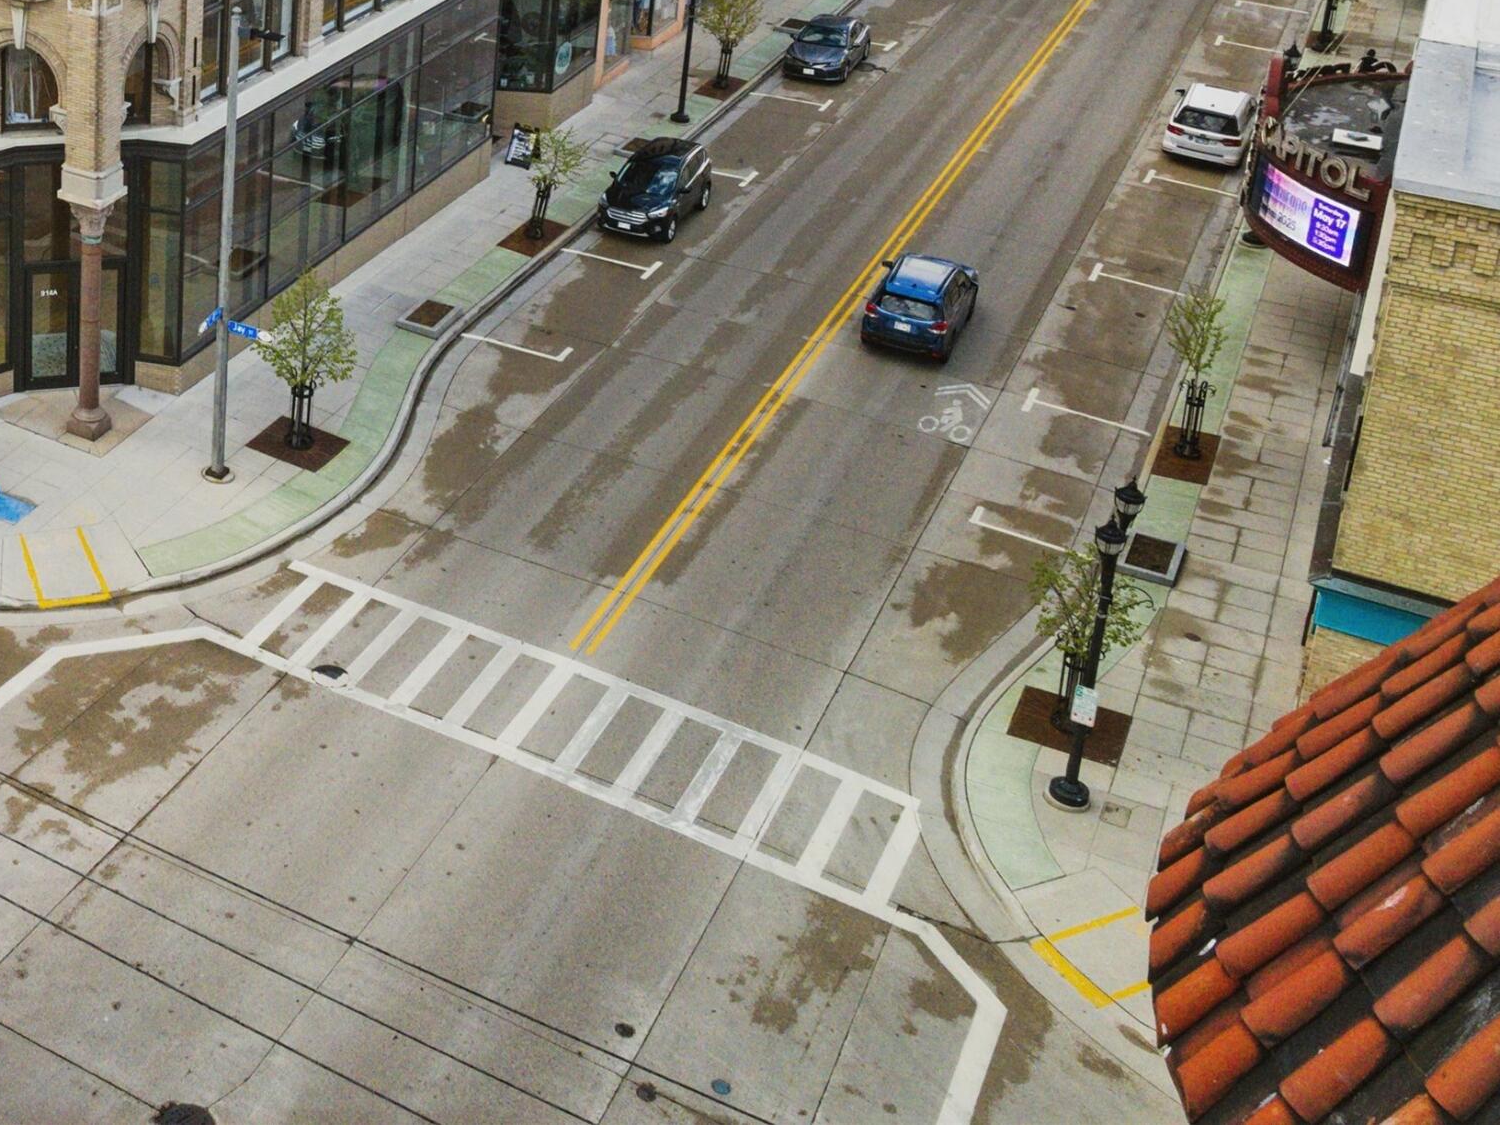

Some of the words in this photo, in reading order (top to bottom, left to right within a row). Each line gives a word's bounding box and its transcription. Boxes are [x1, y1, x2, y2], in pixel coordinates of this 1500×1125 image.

[1261, 117, 1372, 202] CAPITOL
[1313, 208, 1336, 226] May
[1335, 217, 1348, 230] 17
